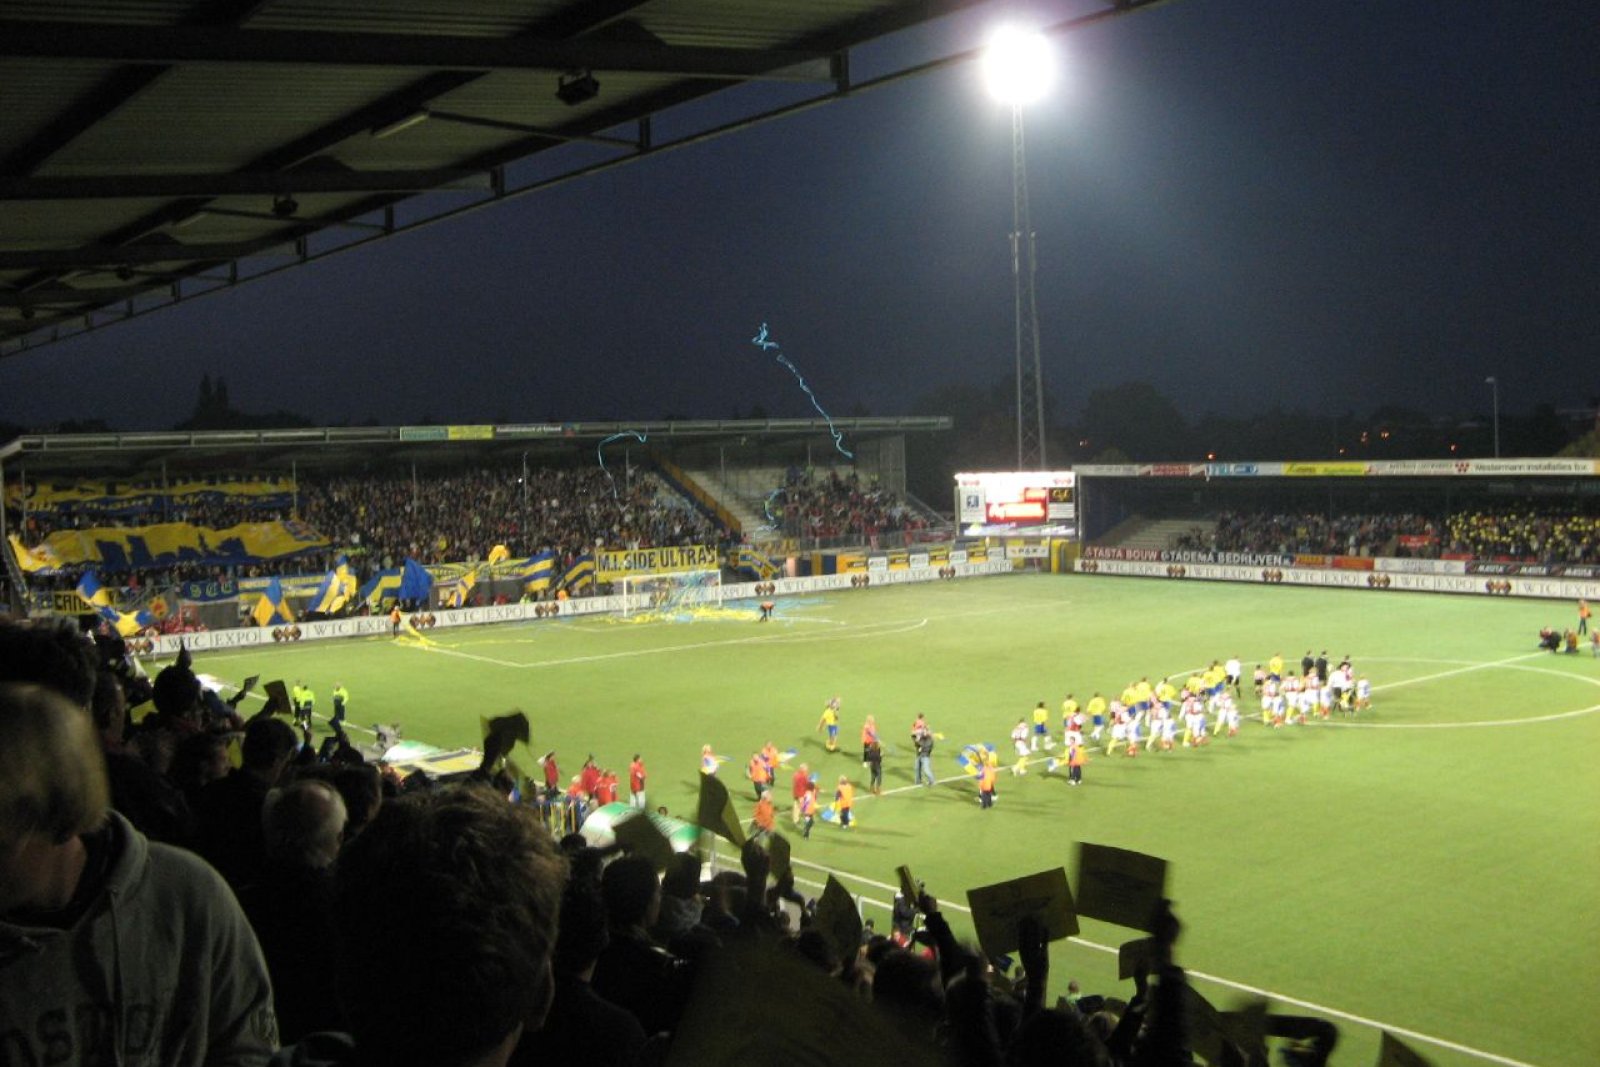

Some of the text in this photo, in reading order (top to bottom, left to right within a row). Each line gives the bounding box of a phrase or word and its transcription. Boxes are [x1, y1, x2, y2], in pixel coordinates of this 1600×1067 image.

[624, 551, 656, 569] SIDE
[660, 547, 716, 568] ULTRAS
[1400, 575, 1473, 591] WTC EXPO
[1523, 581, 1556, 595] WTC
[448, 606, 522, 623] WTC EXPO
[314, 621, 348, 635] WTC
[215, 630, 258, 644] EXPO
